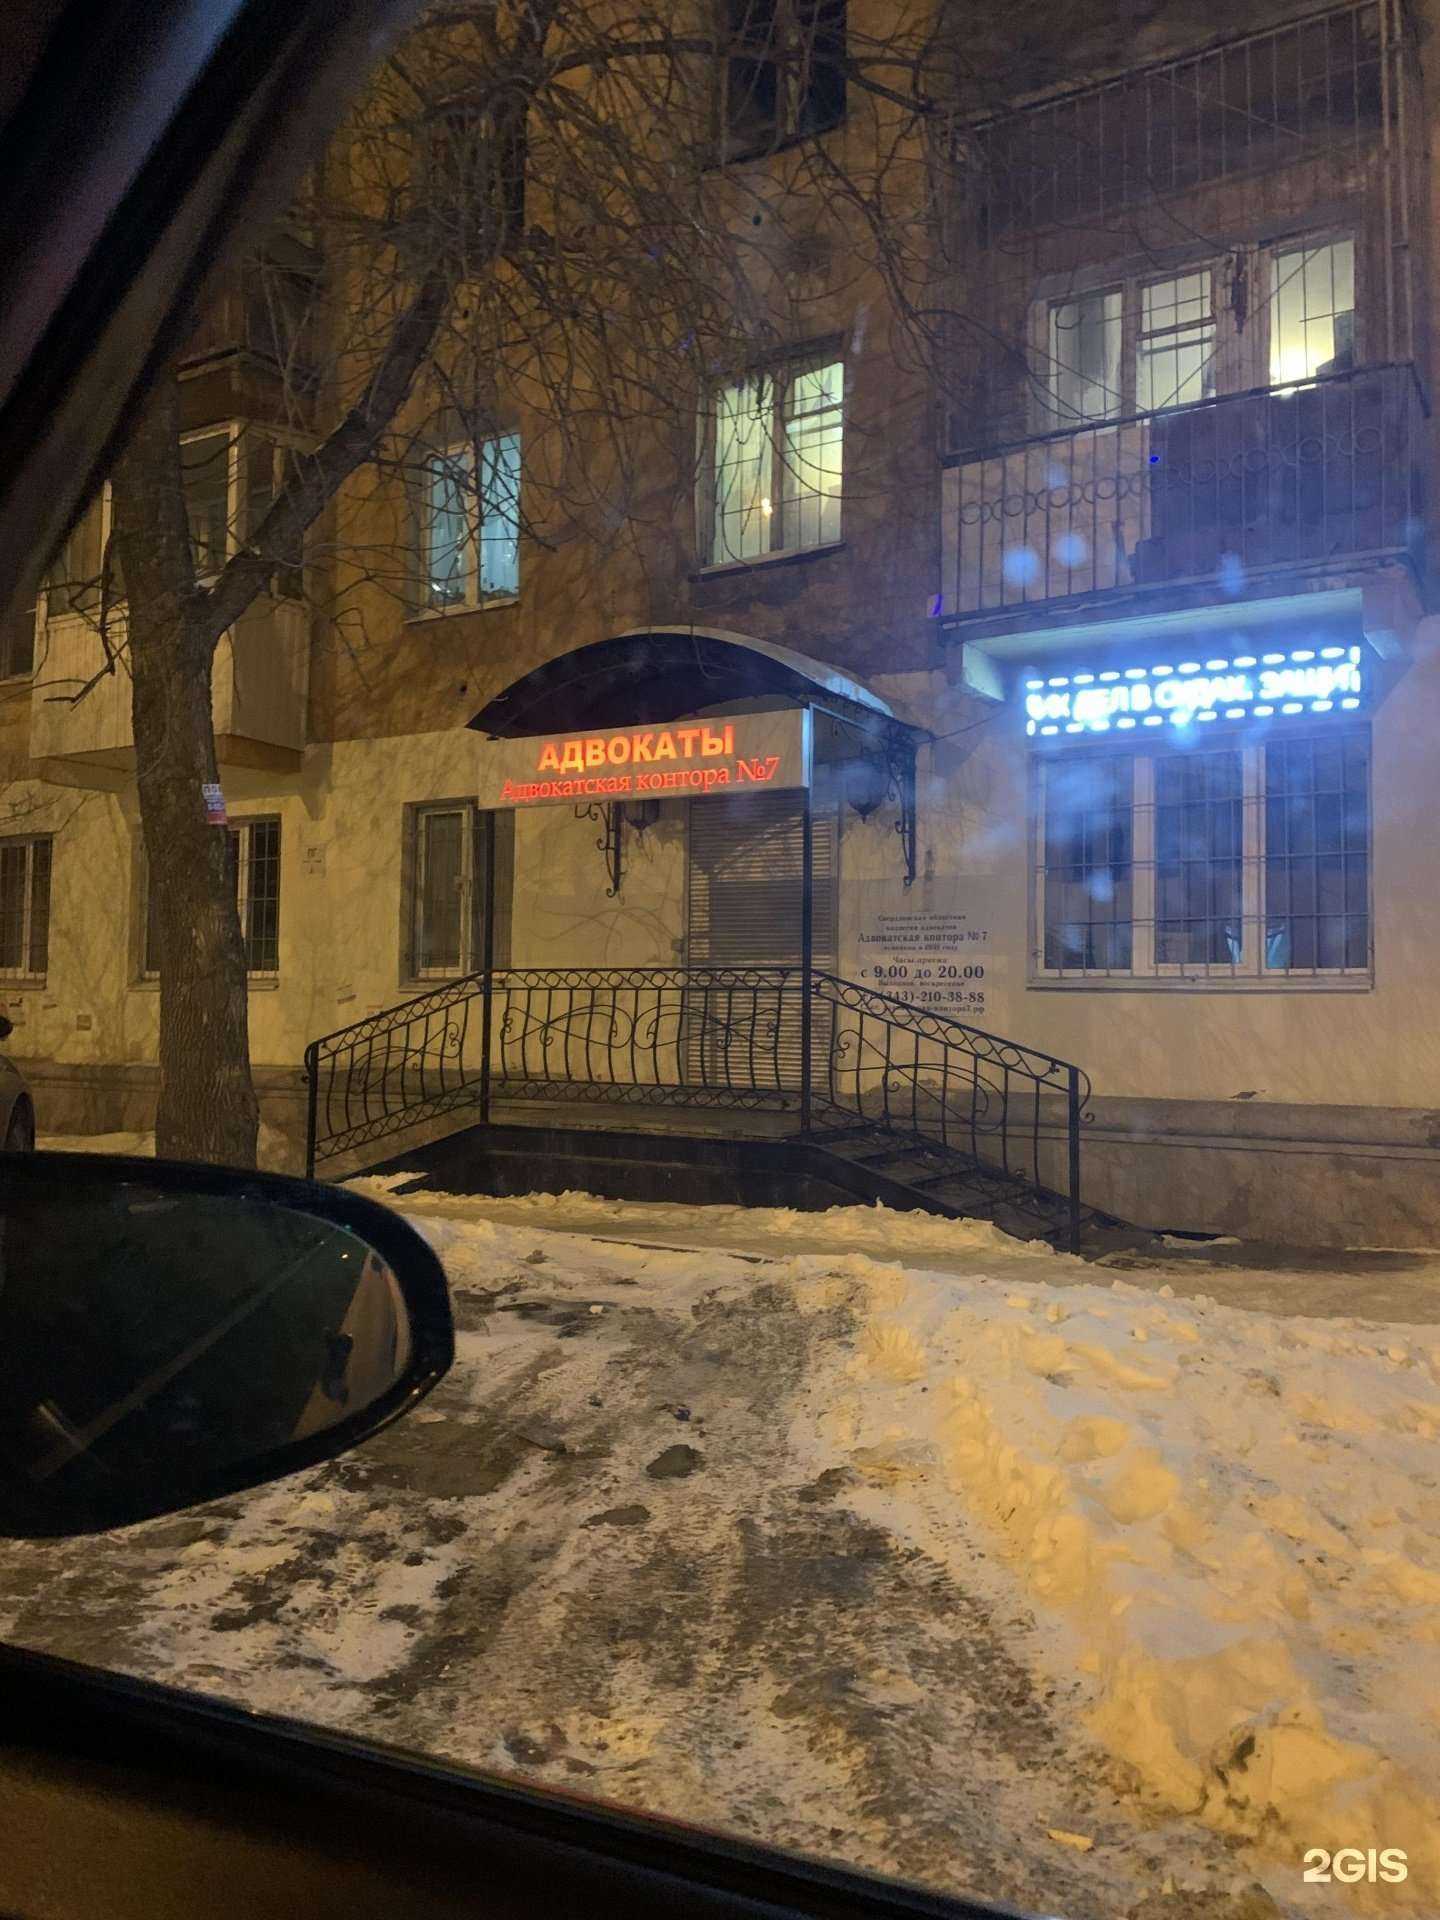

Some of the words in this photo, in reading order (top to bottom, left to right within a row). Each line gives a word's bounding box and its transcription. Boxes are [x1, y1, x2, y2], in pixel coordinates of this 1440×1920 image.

[537, 725, 734, 773] АДВОКАТЫ
[500, 773, 632, 802] Адвокатская
[636, 765, 729, 793] контора
[736, 757, 780, 783] №7
[924, 933, 964, 945] контора
[873, 965, 908, 979] 9.00
[913, 969, 932, 979] до
[938, 965, 985, 979] 20.00
